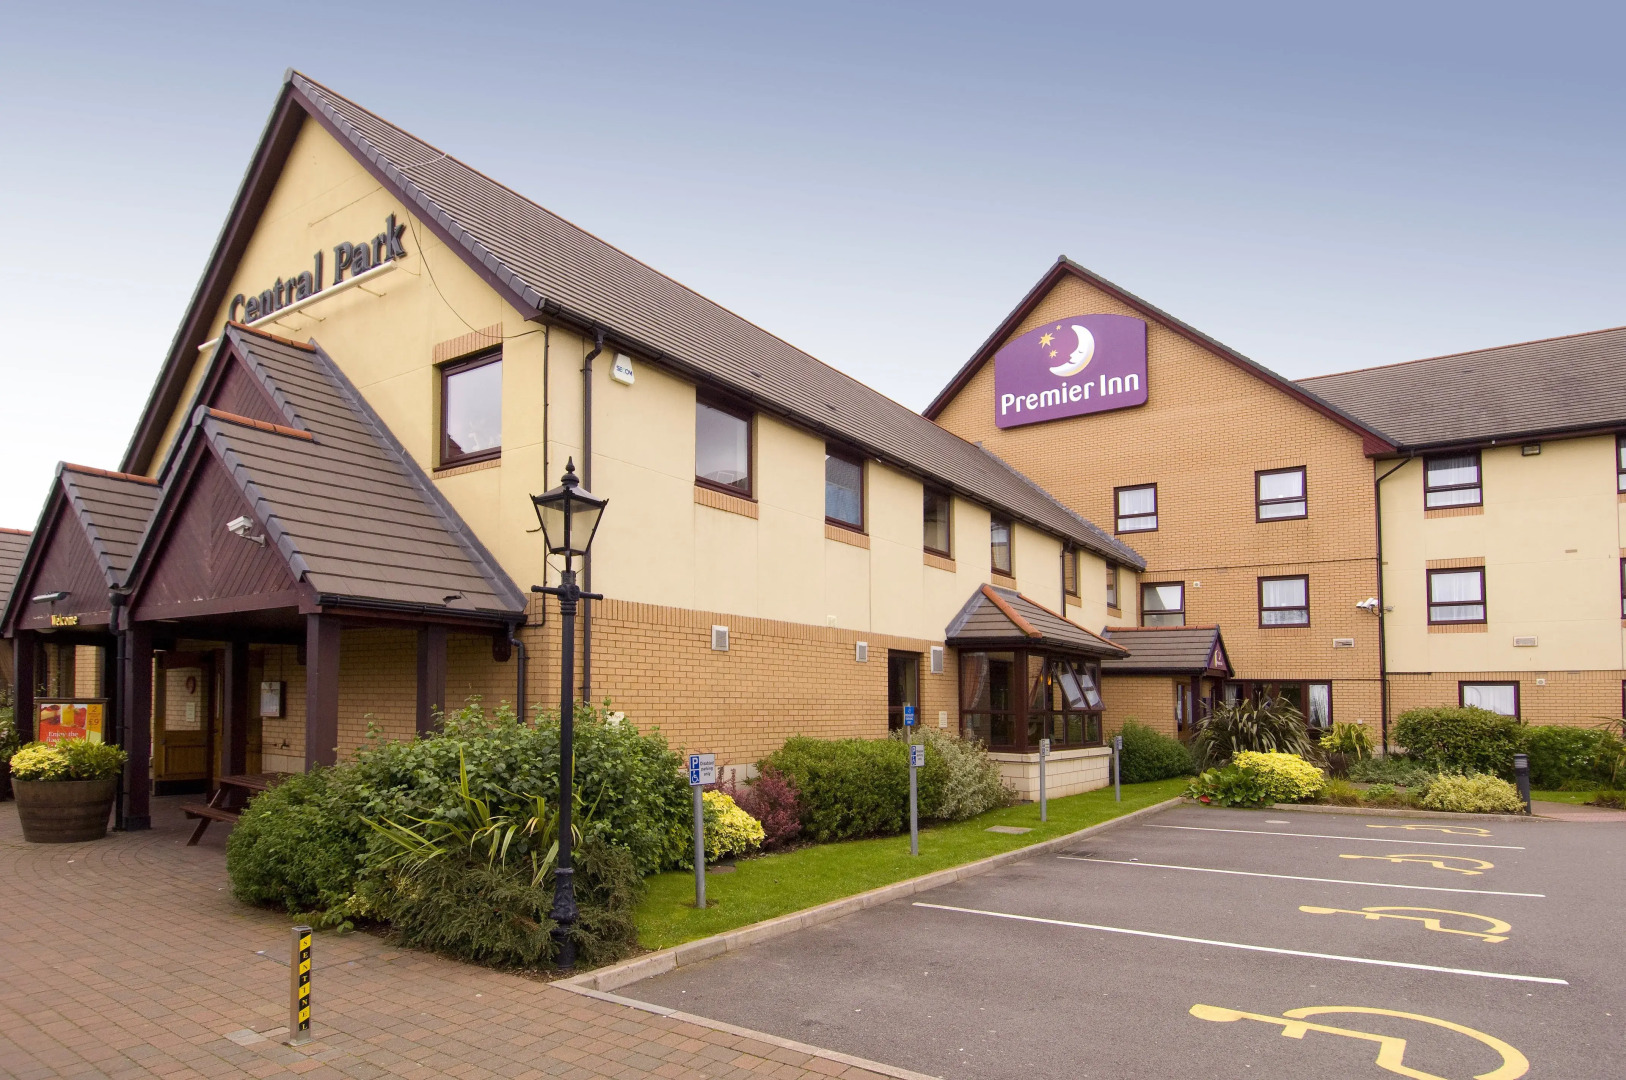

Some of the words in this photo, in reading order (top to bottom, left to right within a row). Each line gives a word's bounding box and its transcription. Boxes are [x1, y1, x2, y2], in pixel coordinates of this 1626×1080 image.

[229, 249, 323, 325] Central
[333, 211, 407, 286] Park
[1001, 382, 1095, 416] Premier
[1100, 373, 1139, 397] Inn
[692, 758, 698, 769] P
